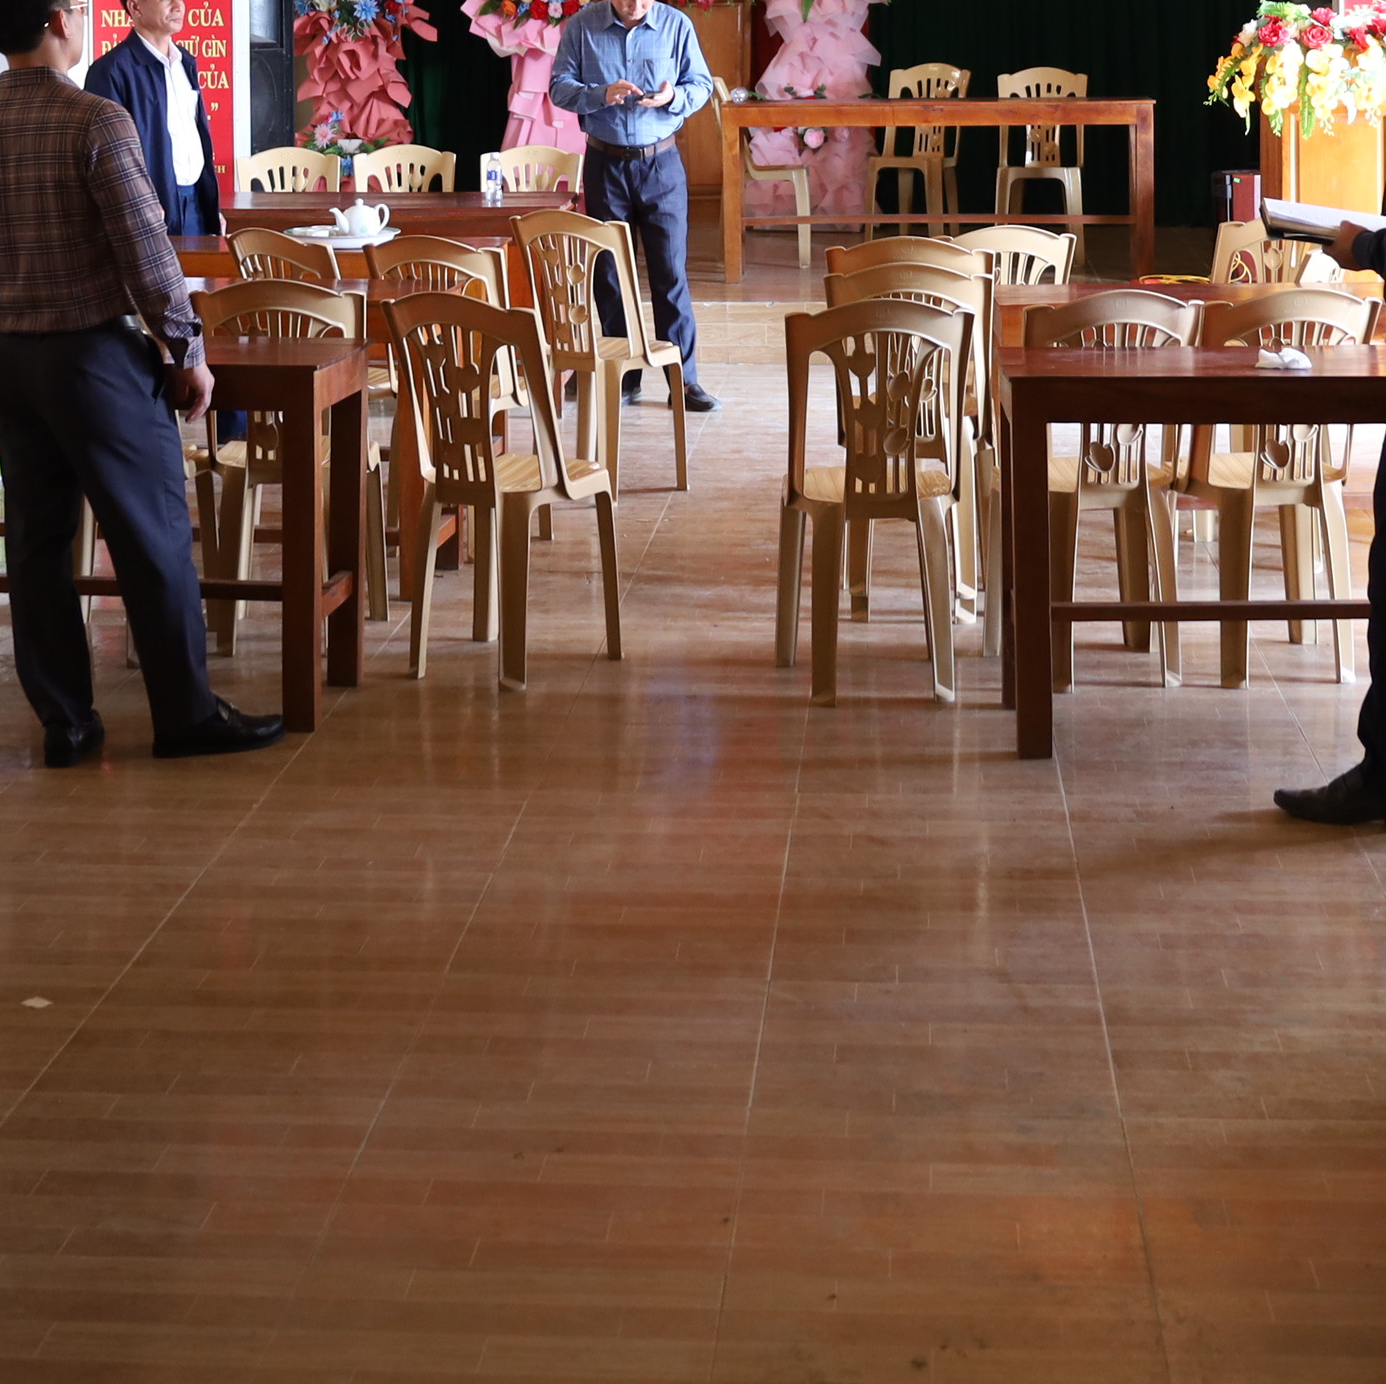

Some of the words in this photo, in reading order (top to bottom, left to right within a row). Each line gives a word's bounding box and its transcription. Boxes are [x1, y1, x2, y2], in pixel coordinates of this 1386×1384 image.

[188, 2, 224, 27] CỦA
[202, 34, 227, 57] GÌN
[198, 64, 229, 88] CỦA
